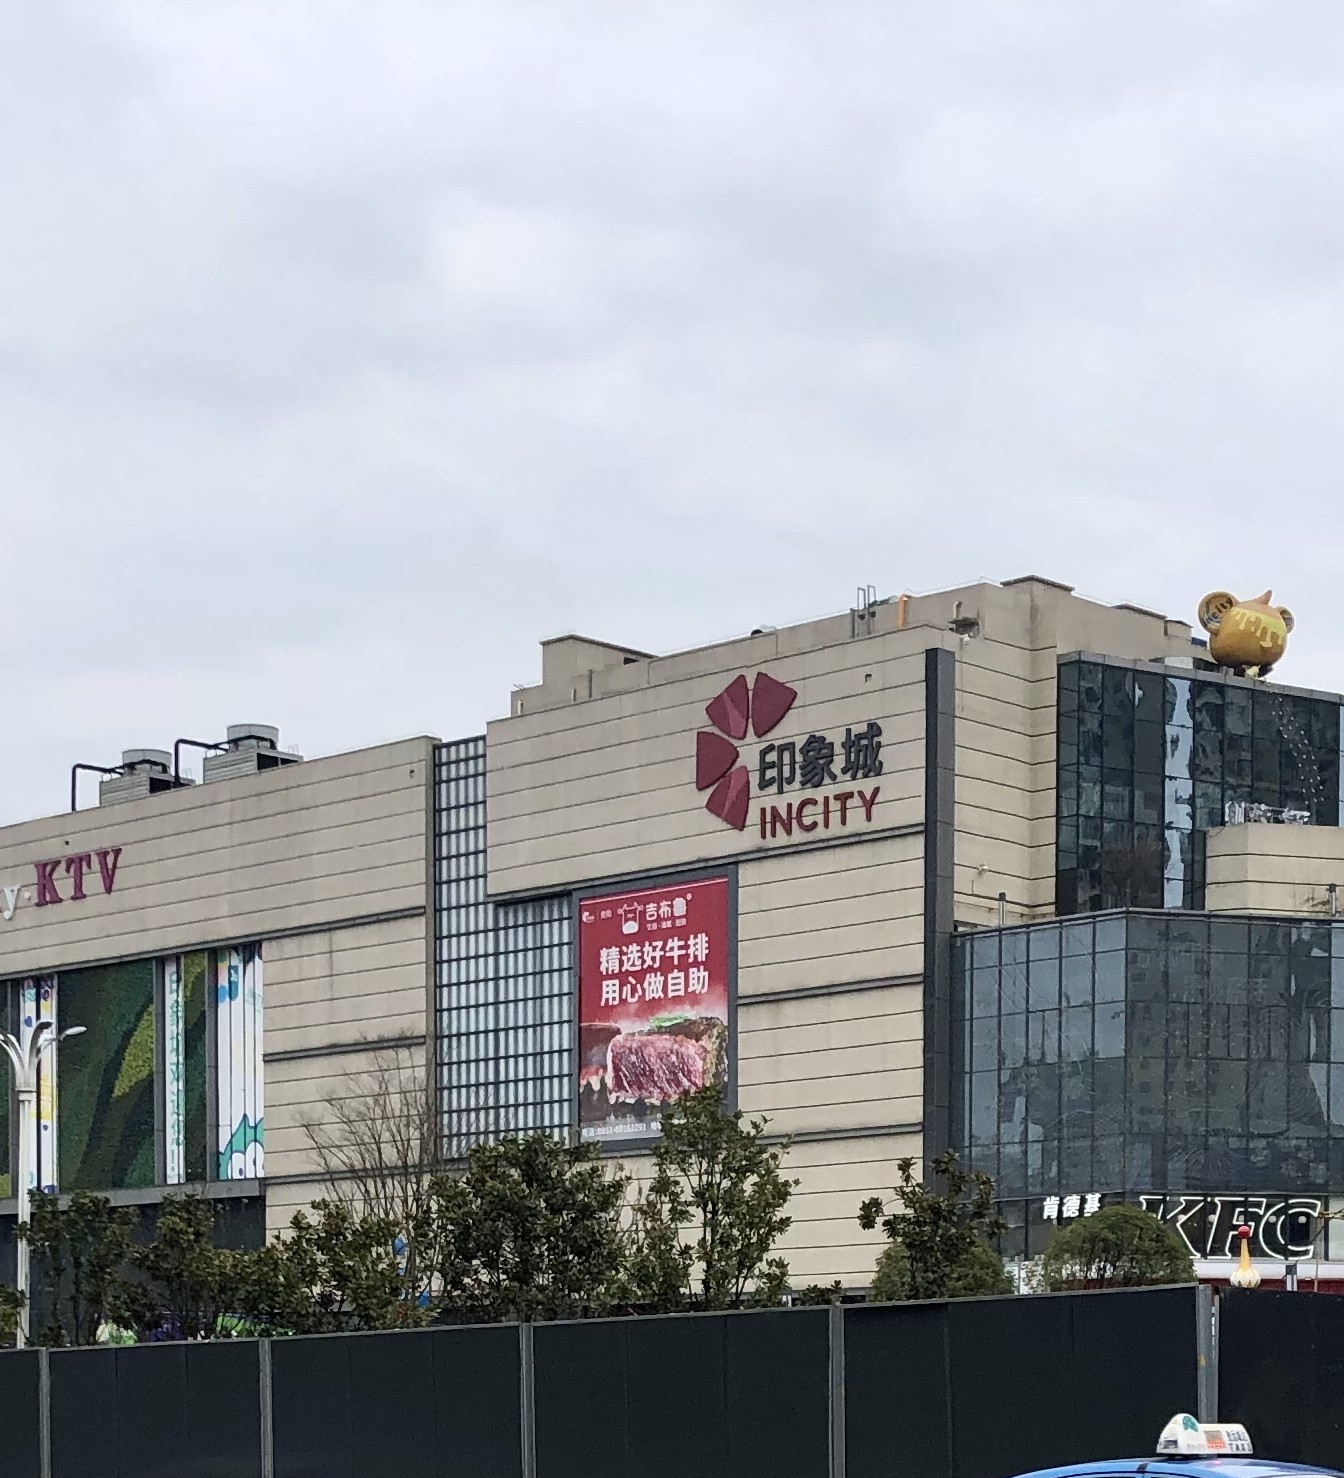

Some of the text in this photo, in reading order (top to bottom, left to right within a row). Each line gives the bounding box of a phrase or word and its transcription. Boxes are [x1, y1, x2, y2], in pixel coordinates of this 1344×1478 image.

[758, 721, 884, 795] 印象城
[760, 786, 881, 840] INCITY
[599, 932, 710, 976] 精选好牛排
[600, 965, 710, 1007] 用心做自助
[1042, 1193, 1102, 1220] 肯德基
[1139, 1195, 1322, 1260] KFC
